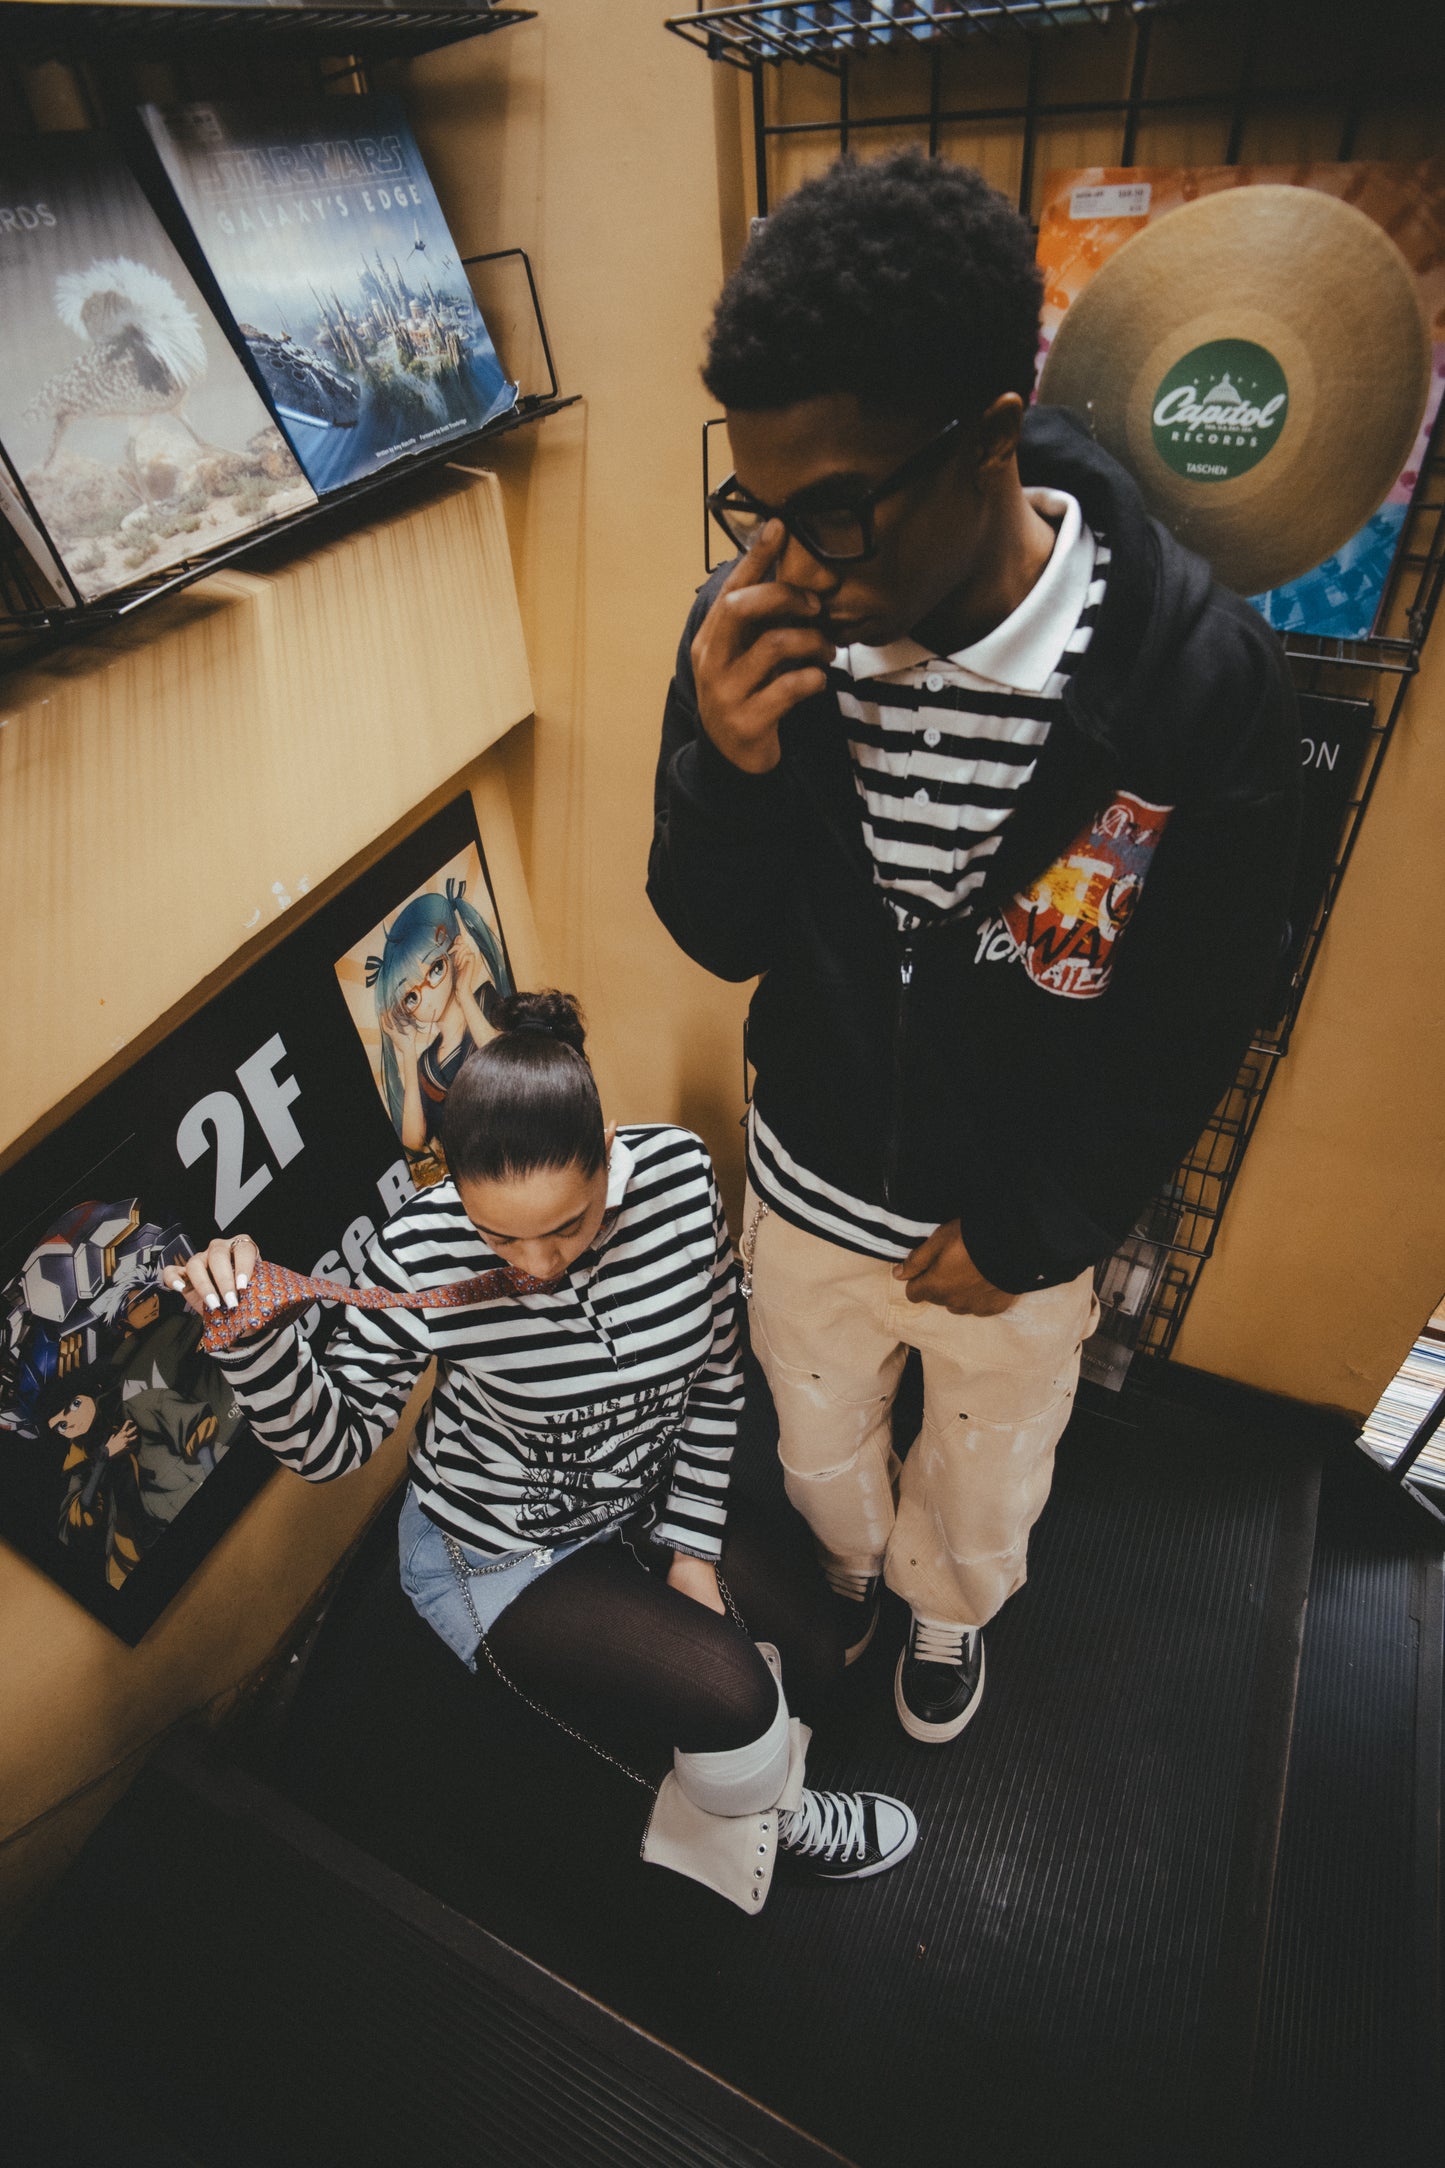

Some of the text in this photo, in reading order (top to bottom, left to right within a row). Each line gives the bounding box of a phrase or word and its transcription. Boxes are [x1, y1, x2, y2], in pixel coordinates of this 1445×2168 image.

[197, 135, 403, 194] STAR WARS
[0, 203, 57, 234] RDS
[216, 184, 422, 235] GALAXY'S EDGE
[1153, 384, 1287, 432] Capitol
[1171, 430, 1259, 448] RECORDS
[1186, 462, 1229, 475] TASCHEN
[1300, 738, 1340, 771] ON
[176, 1031, 306, 1232] 2F
